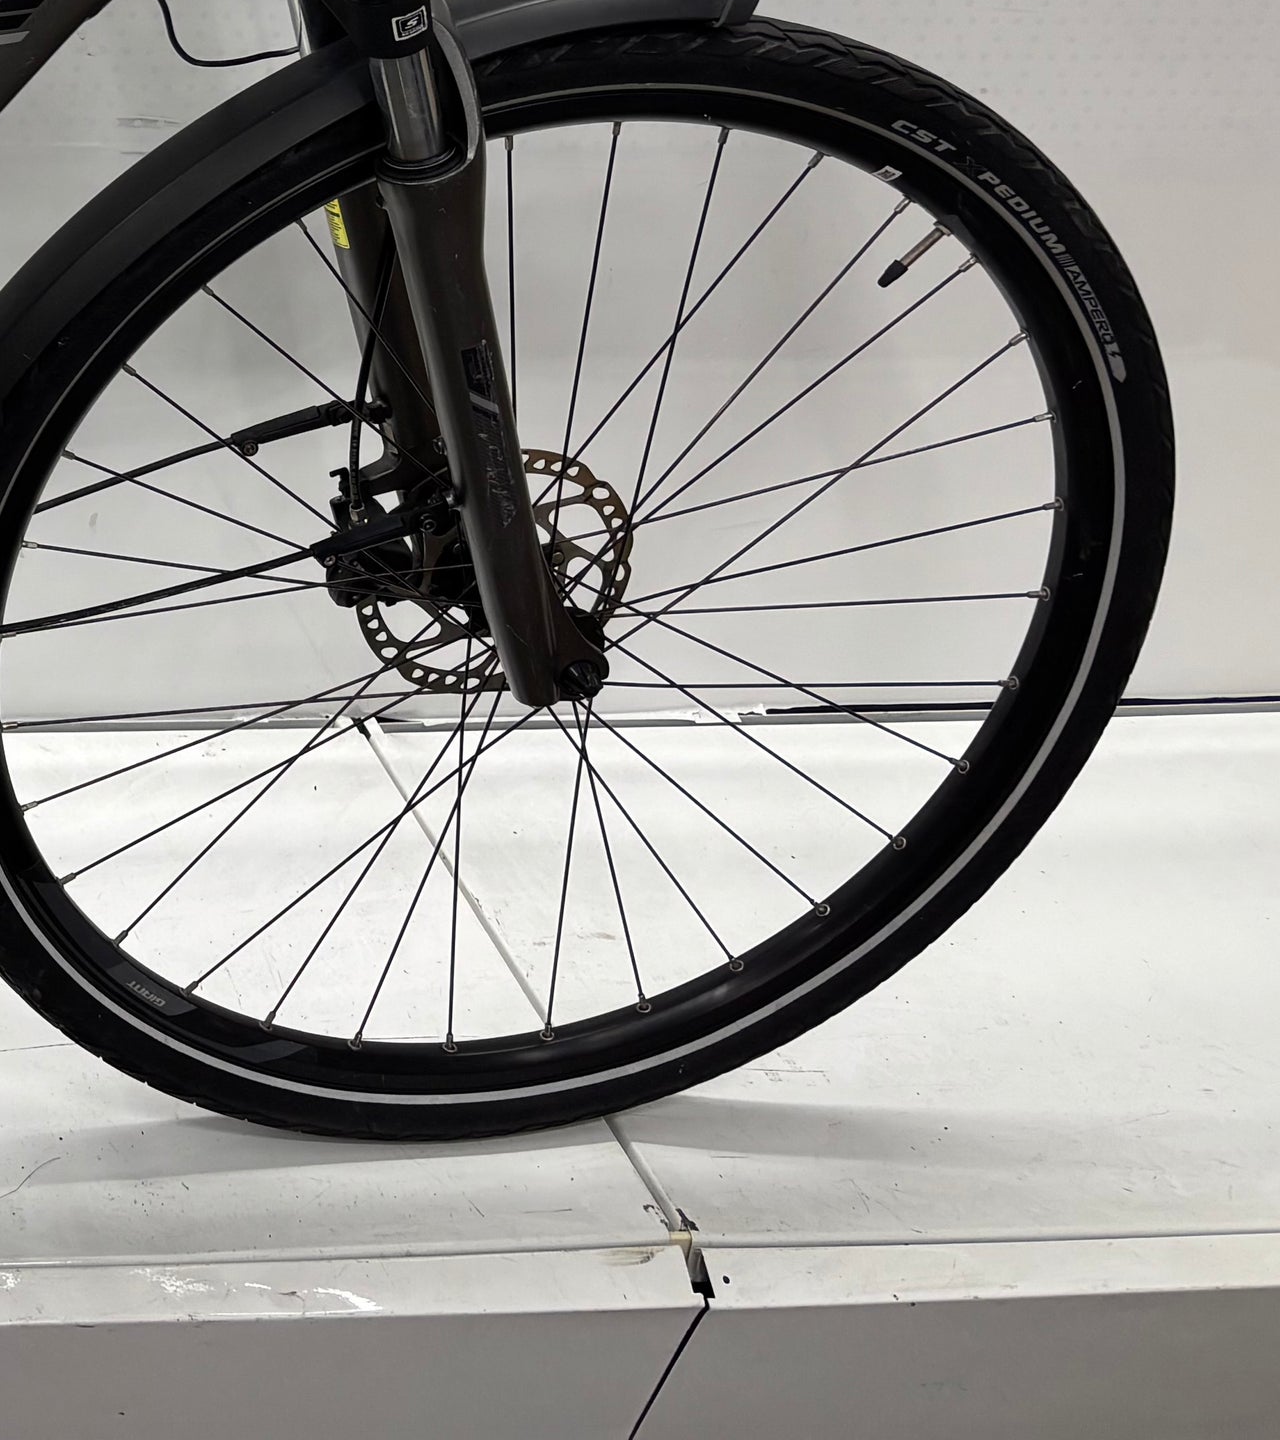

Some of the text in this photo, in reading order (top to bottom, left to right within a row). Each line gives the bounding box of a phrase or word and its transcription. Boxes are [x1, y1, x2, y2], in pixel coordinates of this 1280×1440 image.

[890, 119, 957, 152] CST
[952, 155, 1067, 260] XPEDIUM
[125, 980, 166, 1007] GIANT
